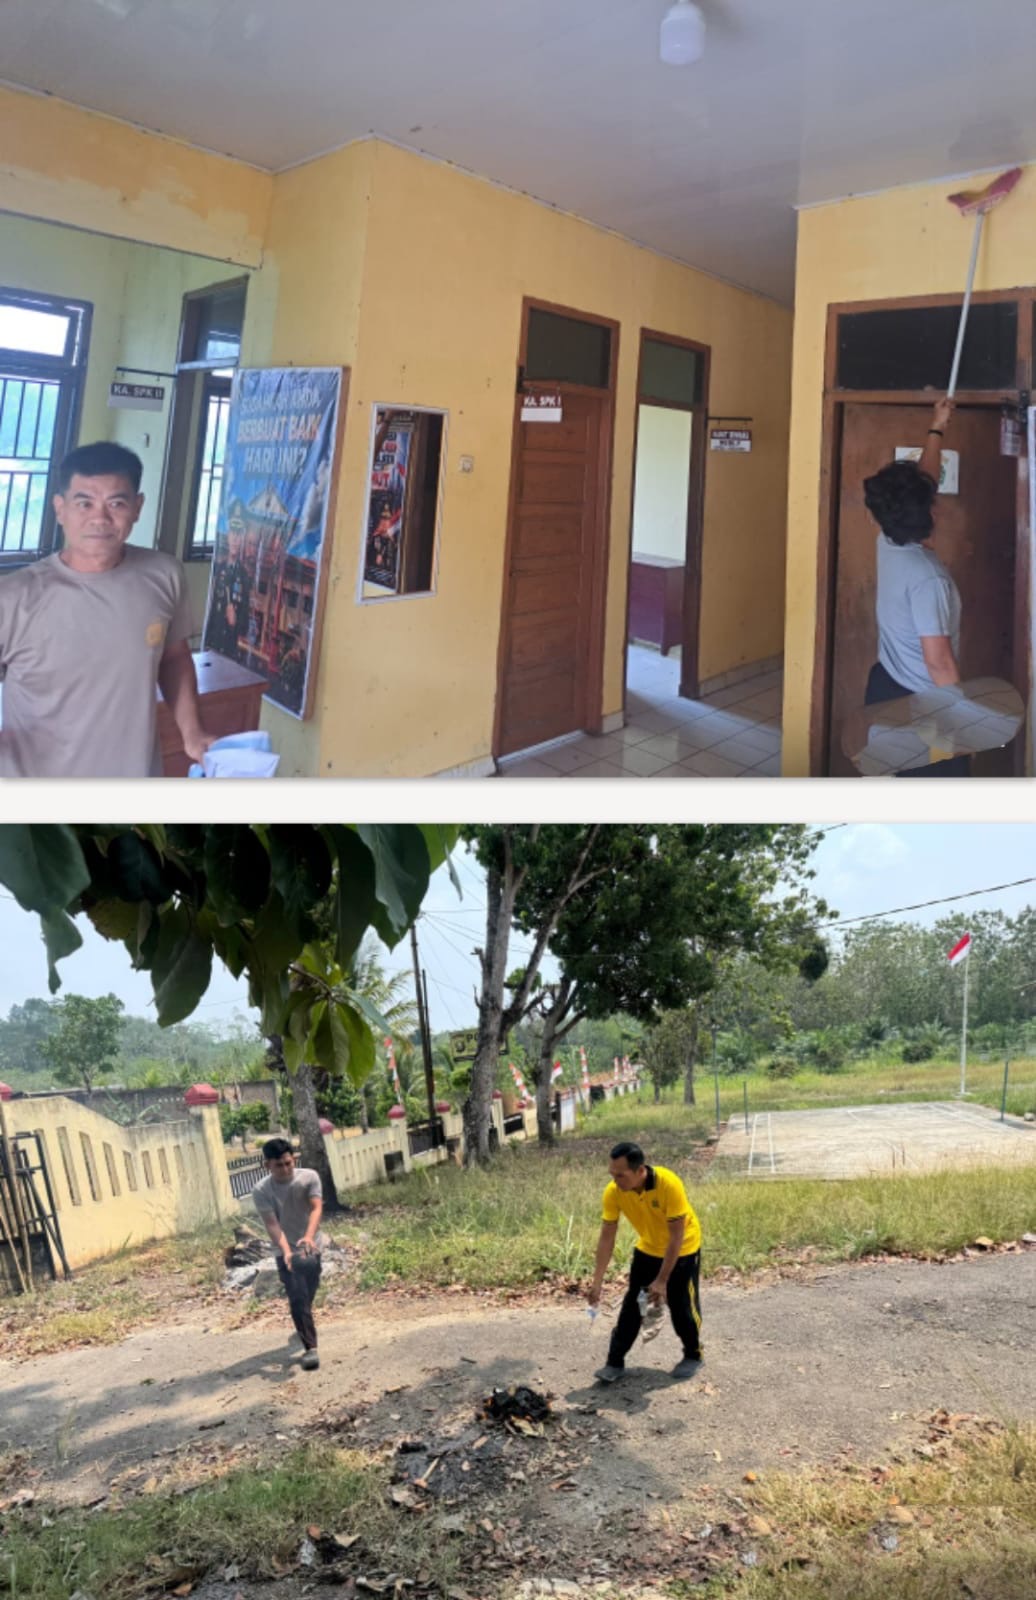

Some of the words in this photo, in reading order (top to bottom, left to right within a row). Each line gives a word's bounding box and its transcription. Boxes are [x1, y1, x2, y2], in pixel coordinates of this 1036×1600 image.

[238, 416, 287, 442] BERBUAT
[288, 414, 322, 441] BAIK
[244, 447, 275, 473] HARI
[277, 447, 307, 474] INI?
